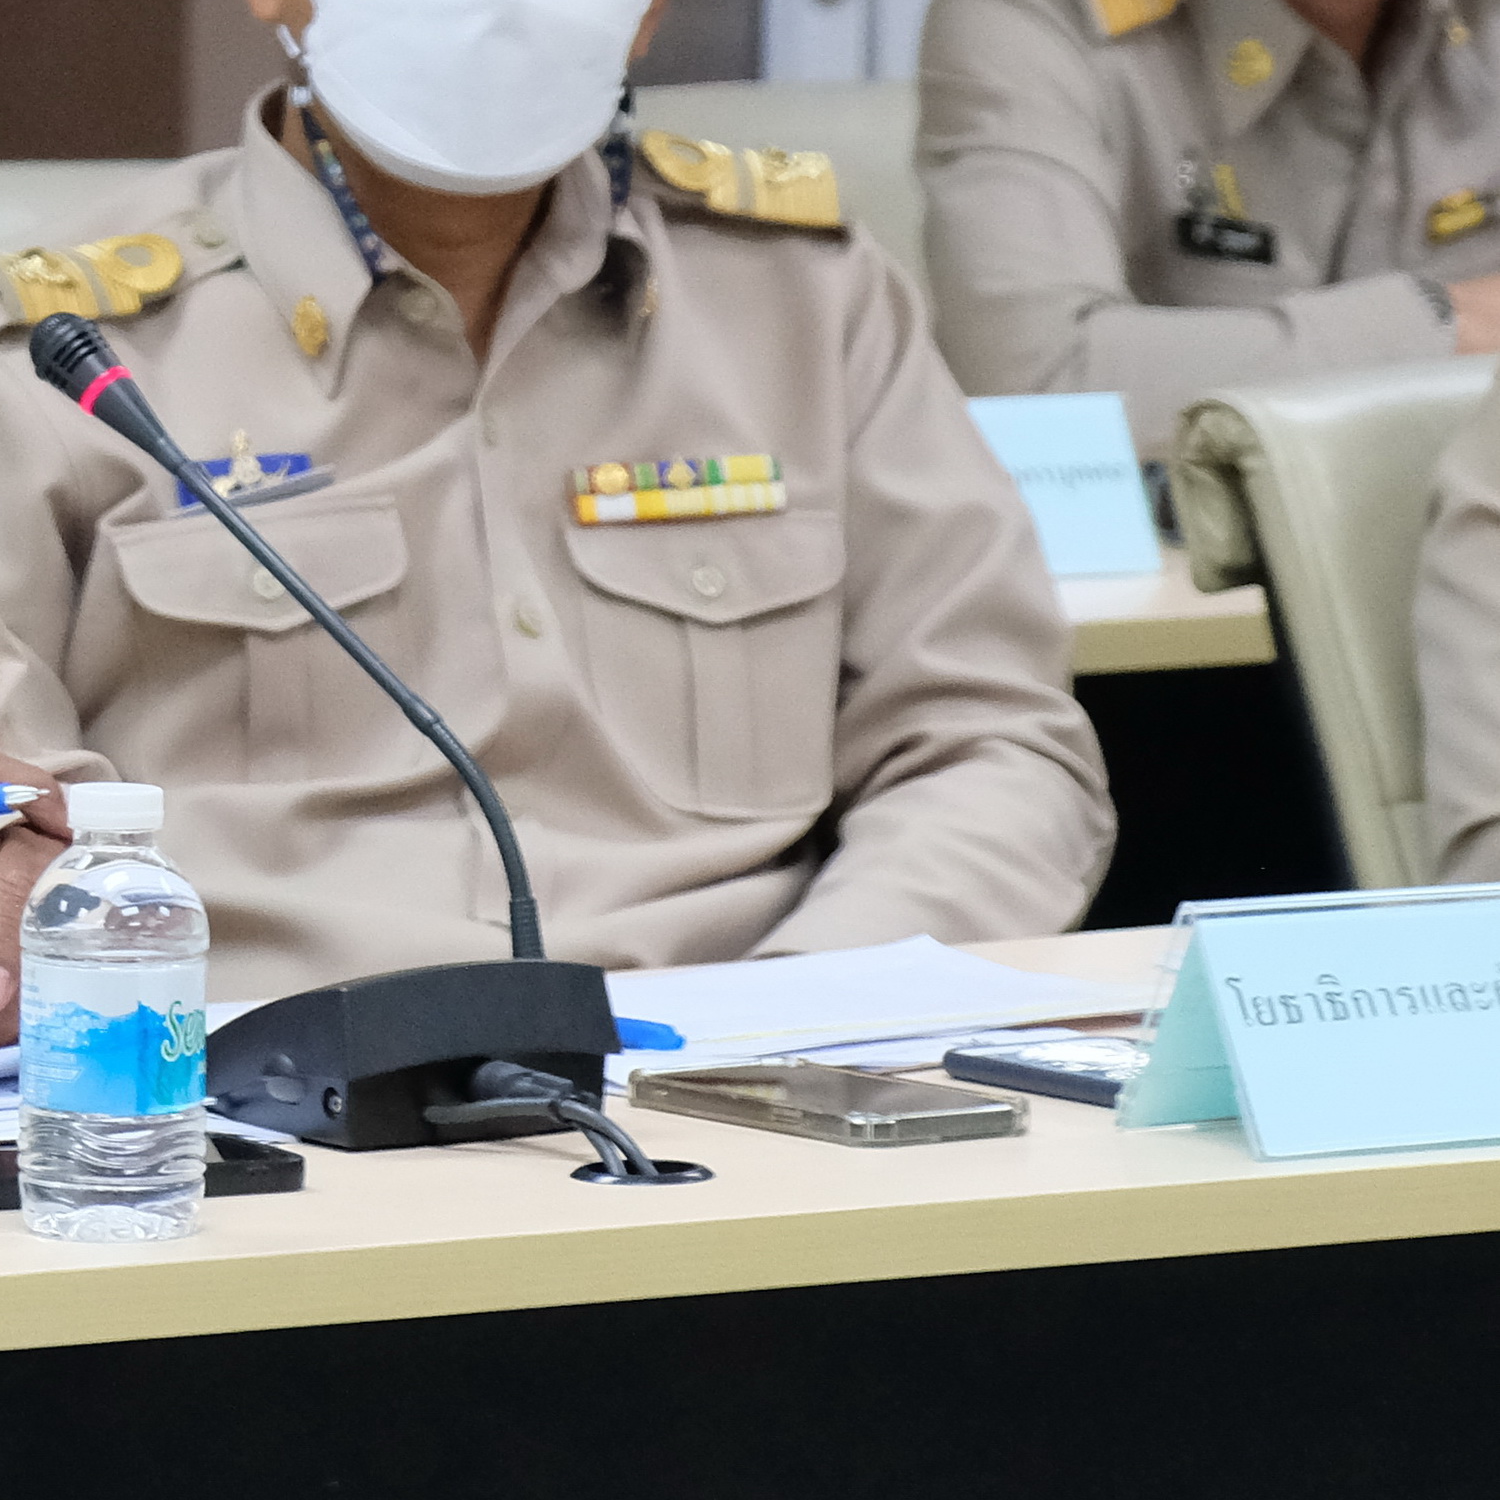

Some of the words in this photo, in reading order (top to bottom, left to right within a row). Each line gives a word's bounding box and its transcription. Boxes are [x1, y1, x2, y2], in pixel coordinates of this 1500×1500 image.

[1225, 962, 1500, 1027] โยธาธิการและ
